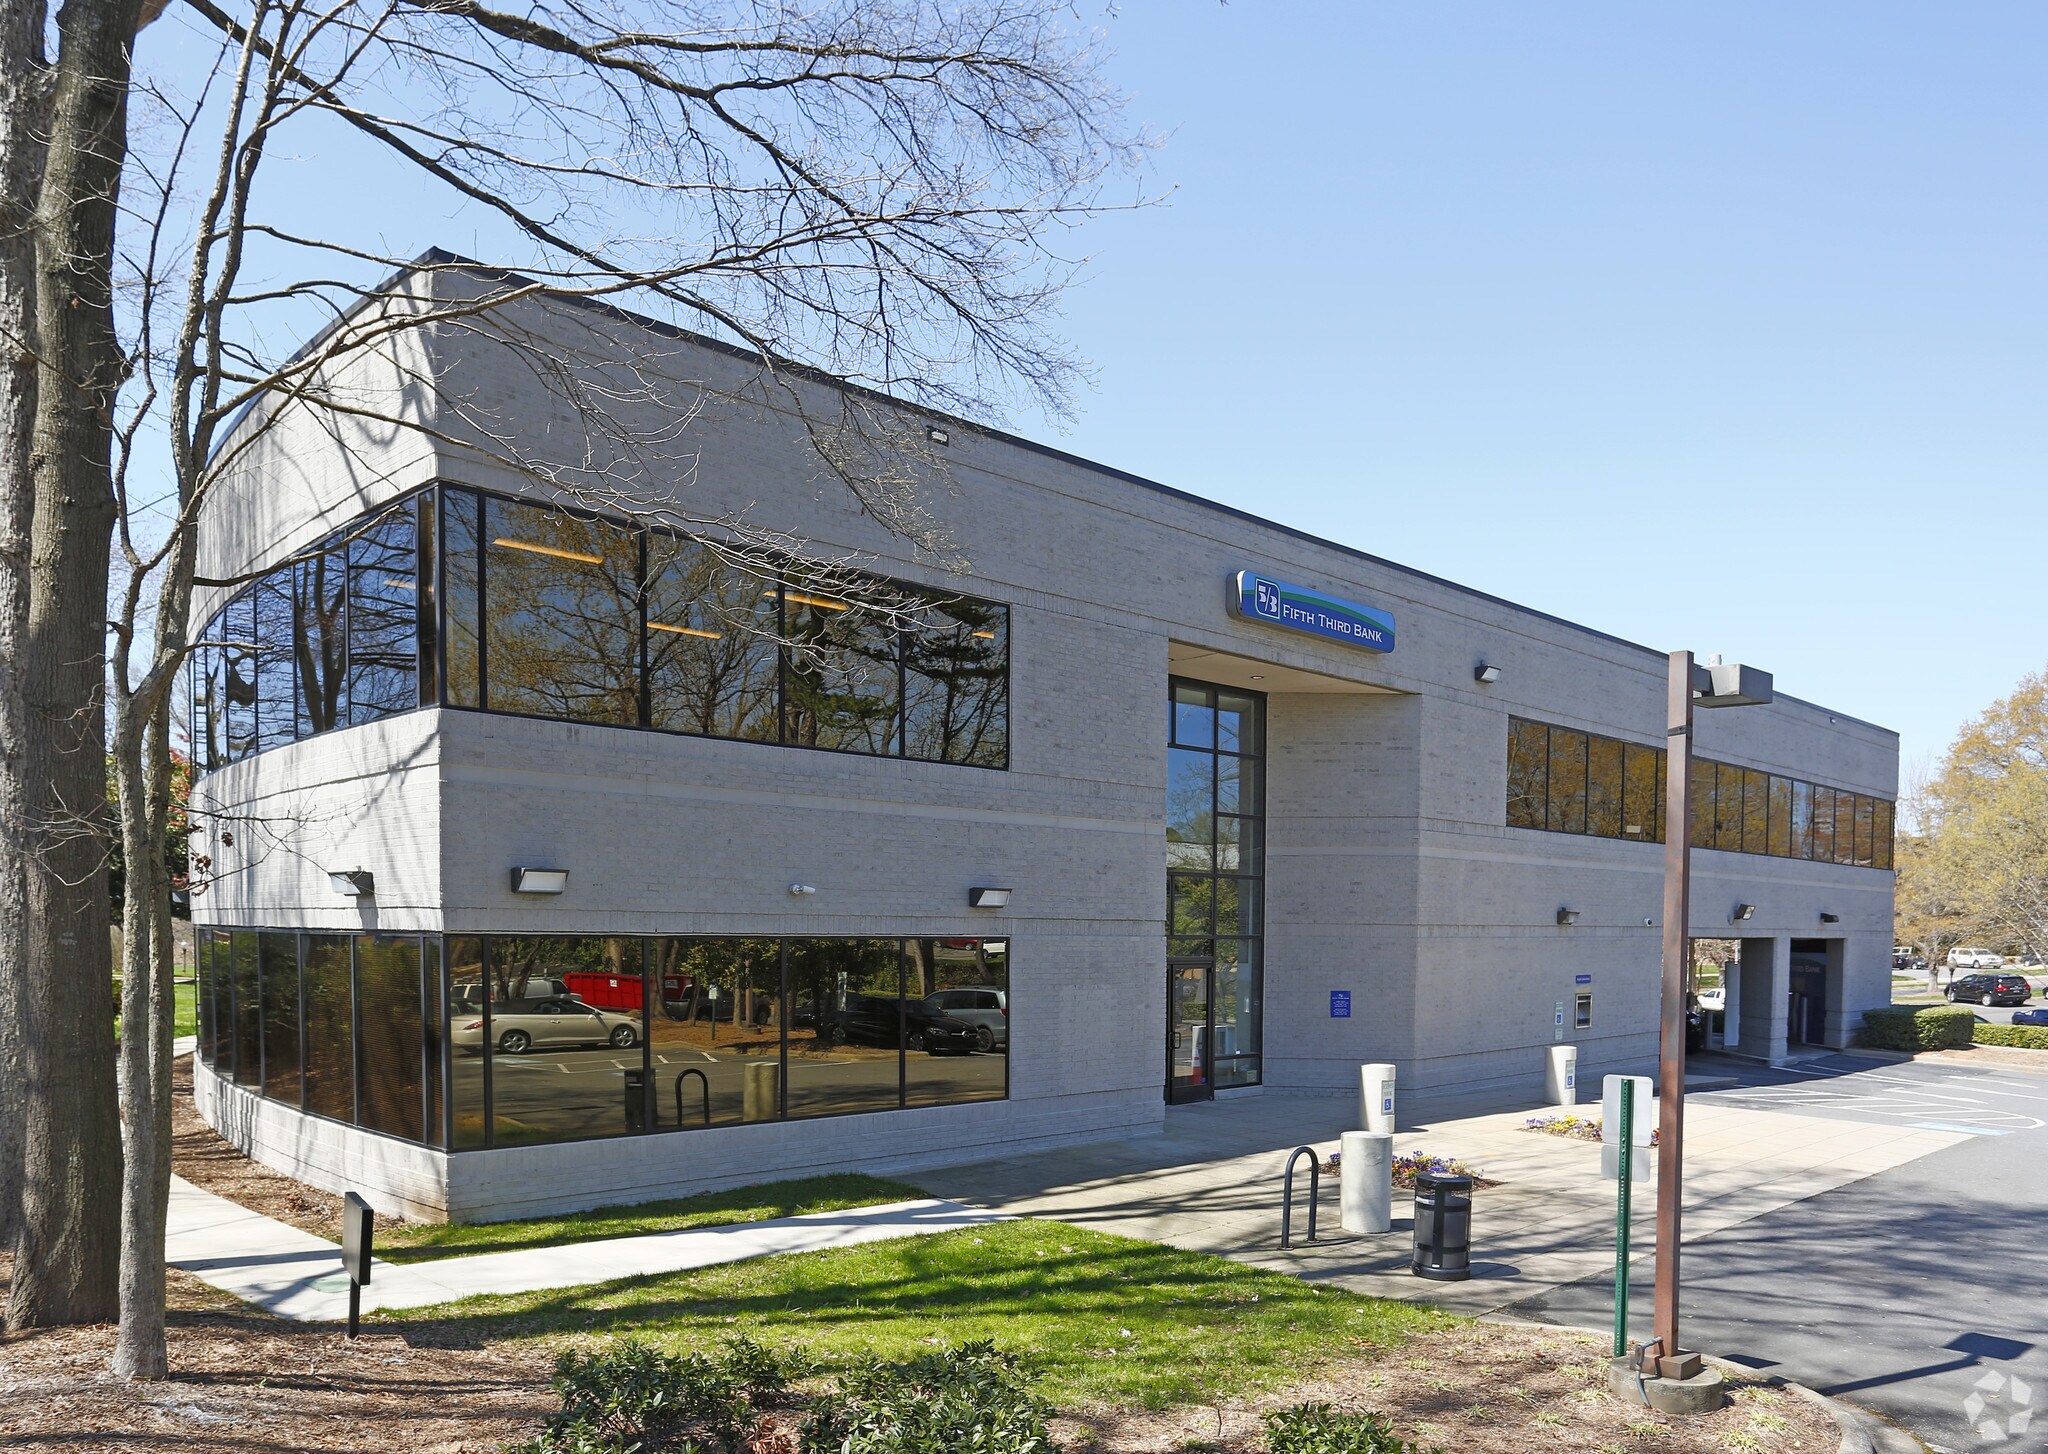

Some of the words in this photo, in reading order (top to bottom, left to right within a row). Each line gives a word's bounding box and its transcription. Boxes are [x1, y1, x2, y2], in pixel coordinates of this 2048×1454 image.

[1283, 604, 1315, 625] FIFTH
[1318, 613, 1351, 634] THIRD
[1353, 624, 1383, 643] BANK
